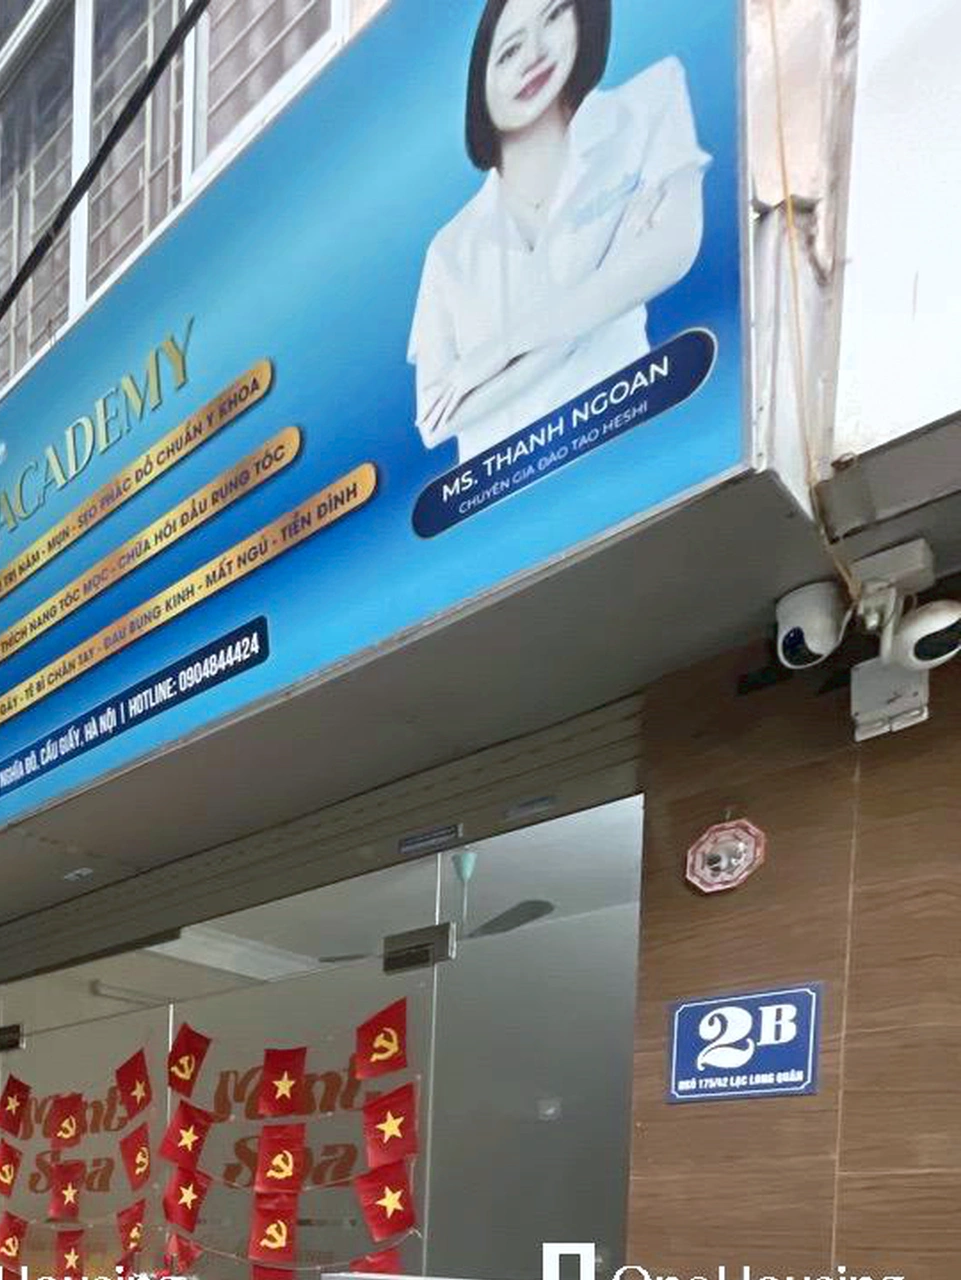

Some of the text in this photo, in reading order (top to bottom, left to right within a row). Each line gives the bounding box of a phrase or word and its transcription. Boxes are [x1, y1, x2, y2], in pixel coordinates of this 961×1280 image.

[207, 411, 215, 428] Y
[218, 376, 261, 419] KHOA
[442, 356, 669, 502] MS. THANH NGOAN
[458, 478, 510, 514] CHUYÊN
[512, 466, 535, 484] GIA
[602, 400, 648, 435] HESHI
[59, 587, 81, 612] TÓC
[153, 519, 178, 546] HÓI
[253, 445, 286, 475] TÓC
[164, 583, 195, 612] KINH
[204, 559, 235, 588] MẤT
[236, 532, 269, 569] NGỦ
[316, 482, 358, 520] ĐÌNH
[84, 718, 100, 743] HÀ
[99, 708, 117, 736] NỘI
[128, 676, 178, 718] HOTLINE:
[178, 632, 260, 693] 0904844424
[697, 1003, 797, 1071] 2B
[749, 1073, 776, 1087] LONG
